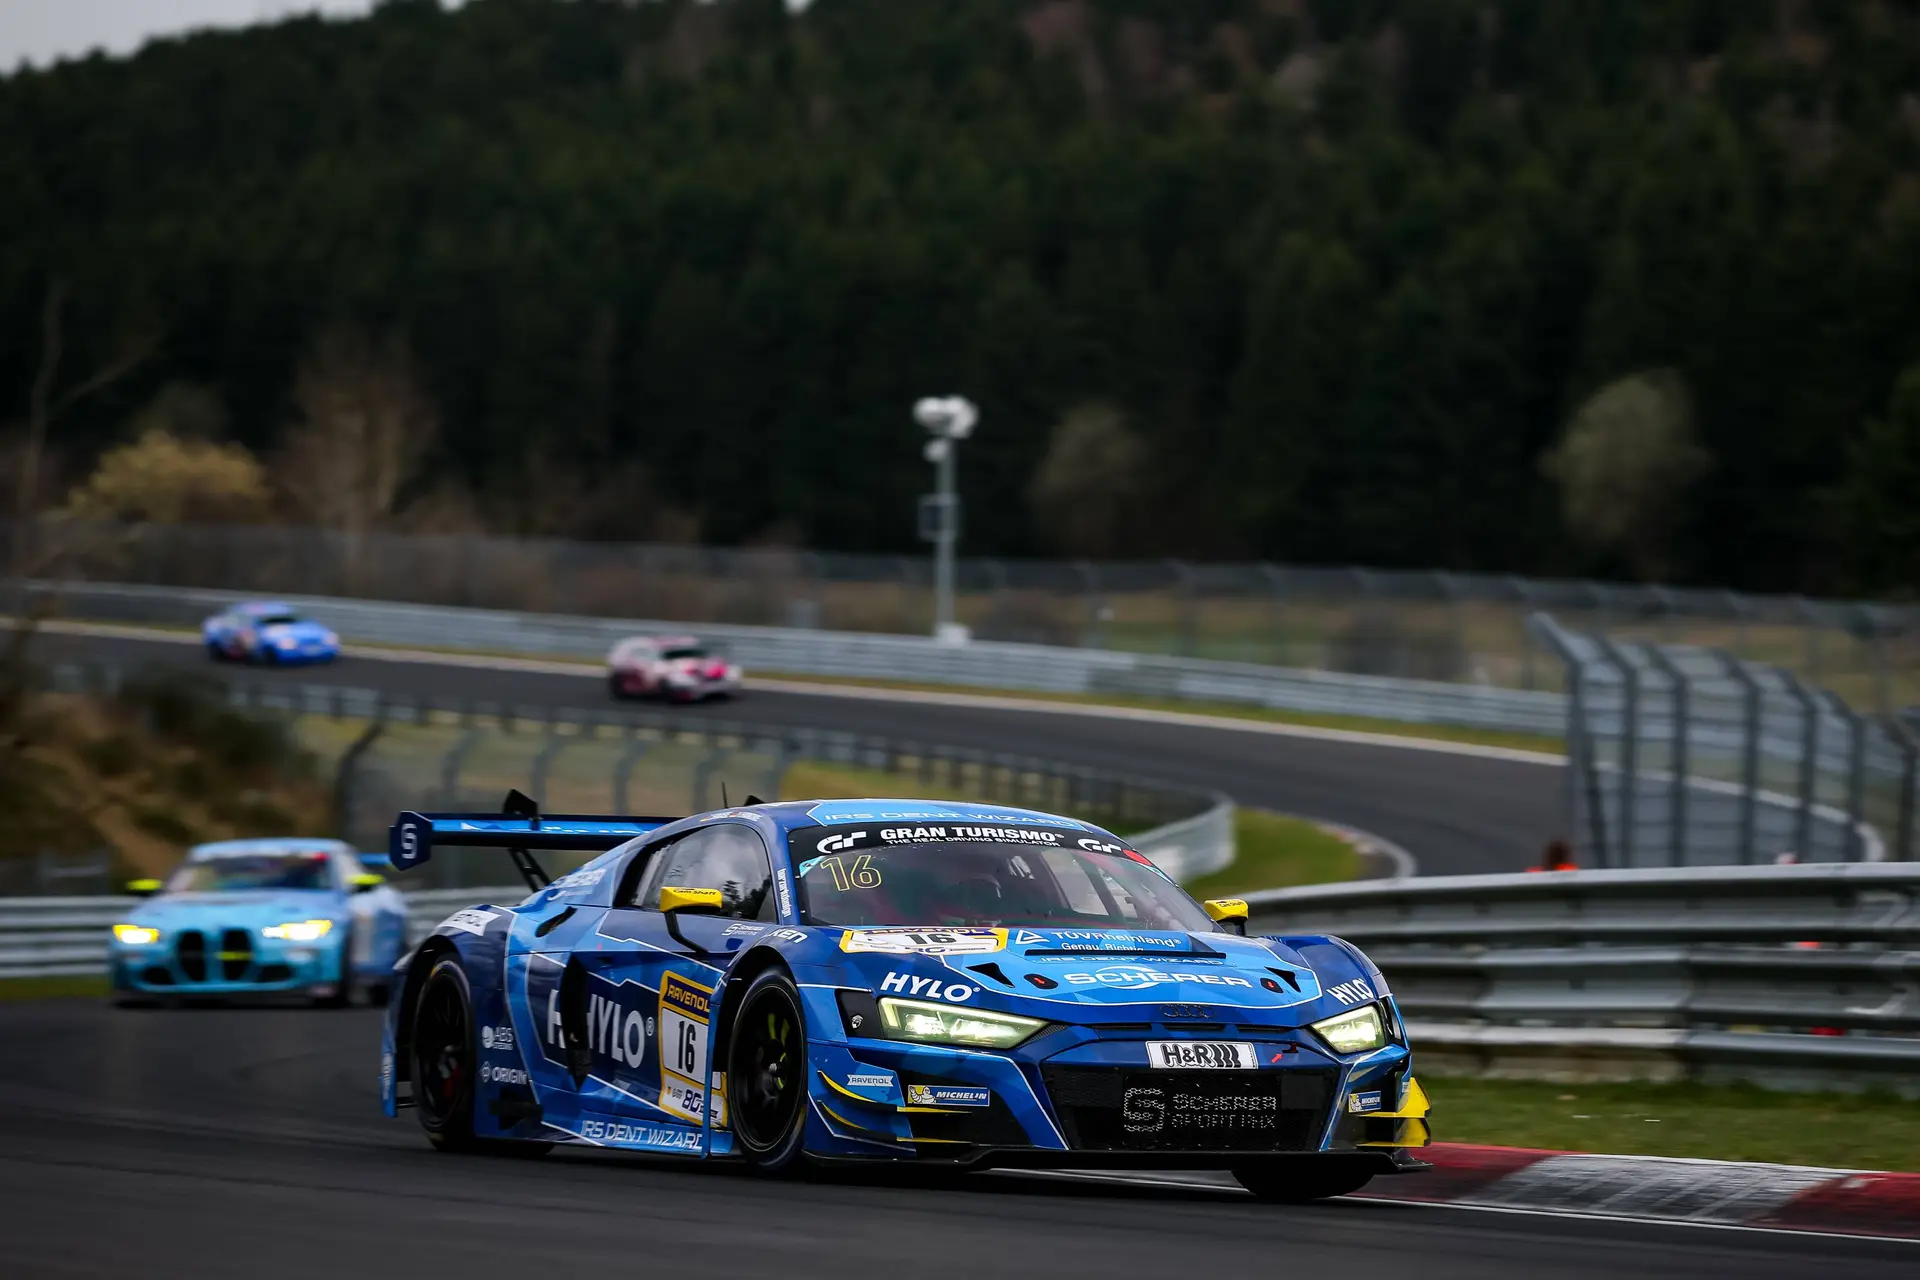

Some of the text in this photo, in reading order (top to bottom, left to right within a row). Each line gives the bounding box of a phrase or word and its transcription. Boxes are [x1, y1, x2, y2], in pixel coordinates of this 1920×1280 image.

[969, 814, 1075, 827] WIZARD
[880, 826, 947, 841] GRAN
[995, 837, 1062, 847] SIMULATOR
[820, 854, 882, 891] 16
[904, 933, 957, 945] 16
[1080, 956, 1137, 964] DENT
[1142, 956, 1224, 966] WIZARD
[1063, 972, 1254, 989] SCHERER
[667, 985, 710, 1013] RAVENOL
[677, 1020, 697, 1074] 16
[1160, 1044, 1215, 1068] H&R
[850, 1077, 889, 1085] RAVENOL
[935, 1090, 988, 1100] MICHELIN
[580, 1120, 606, 1138] IRS
[604, 1124, 647, 1143] DENT
